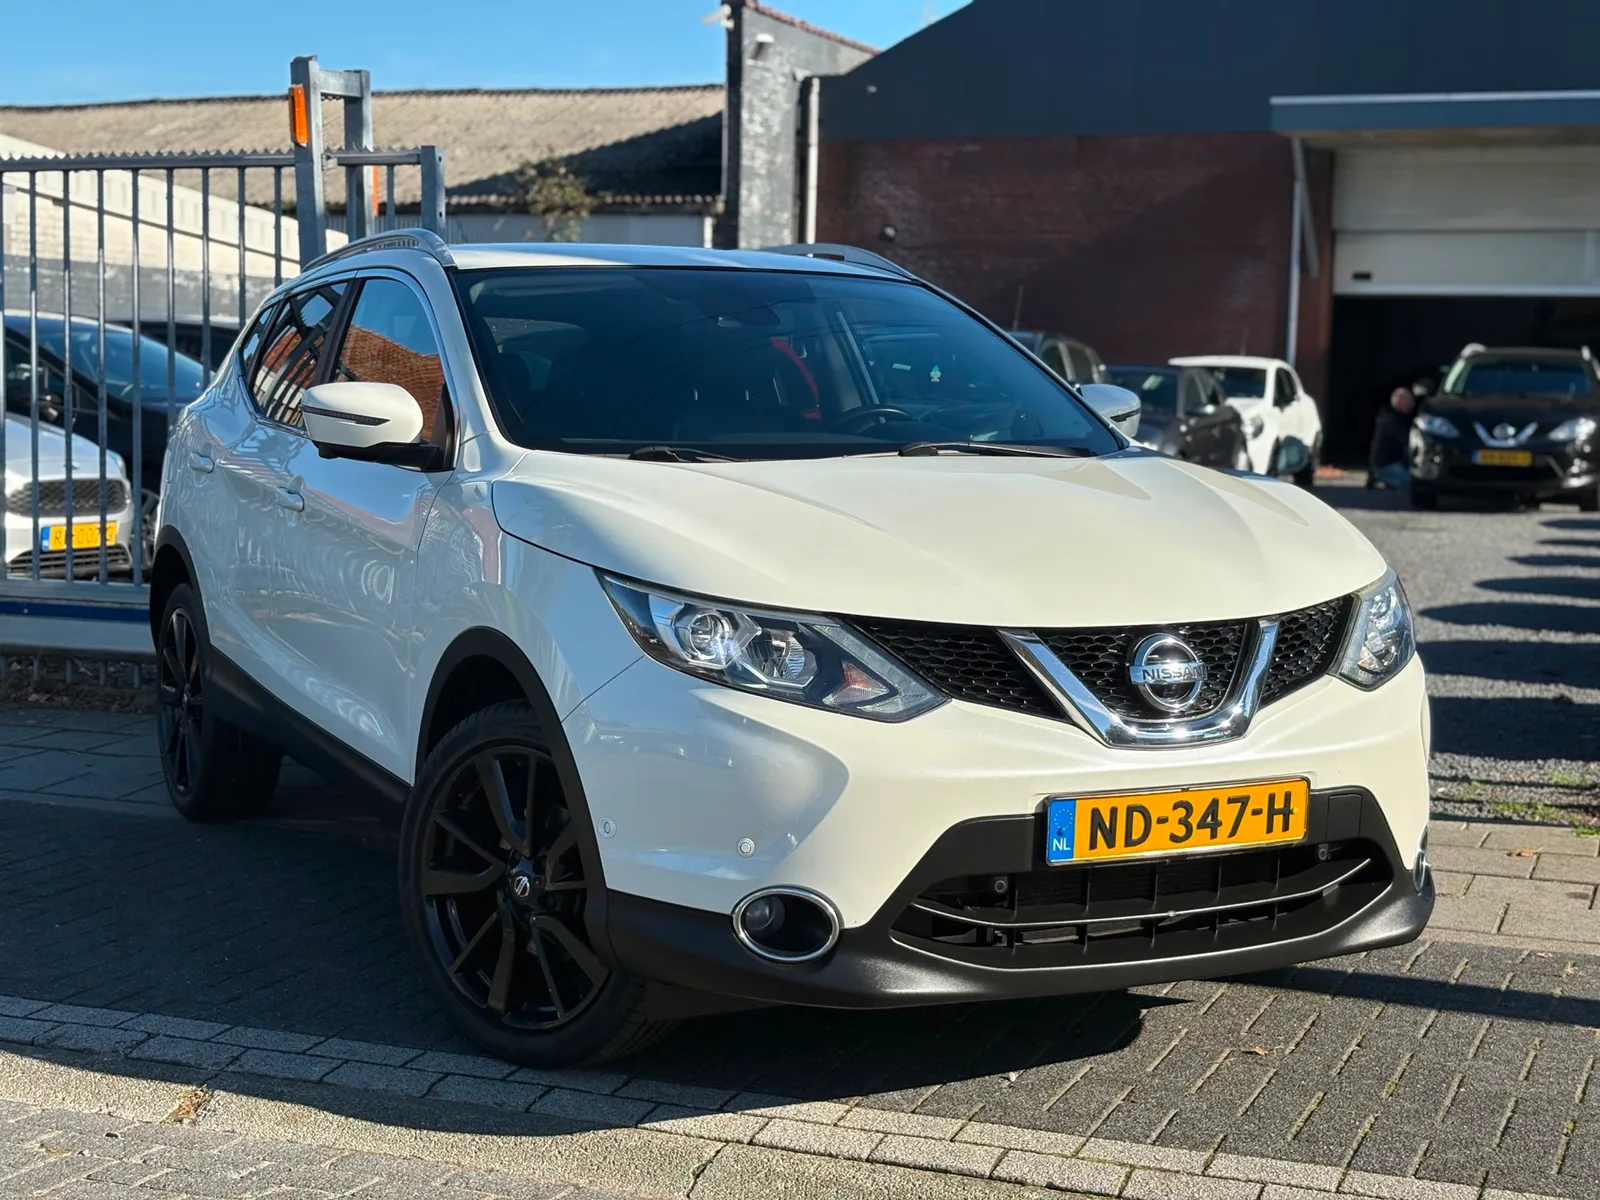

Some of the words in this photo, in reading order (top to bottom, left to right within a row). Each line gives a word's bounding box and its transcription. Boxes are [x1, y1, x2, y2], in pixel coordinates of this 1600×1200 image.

[1142, 663, 1207, 680] NISSAN
[1089, 791, 1292, 850] ND-347-H
[1052, 837, 1071, 851] NL
